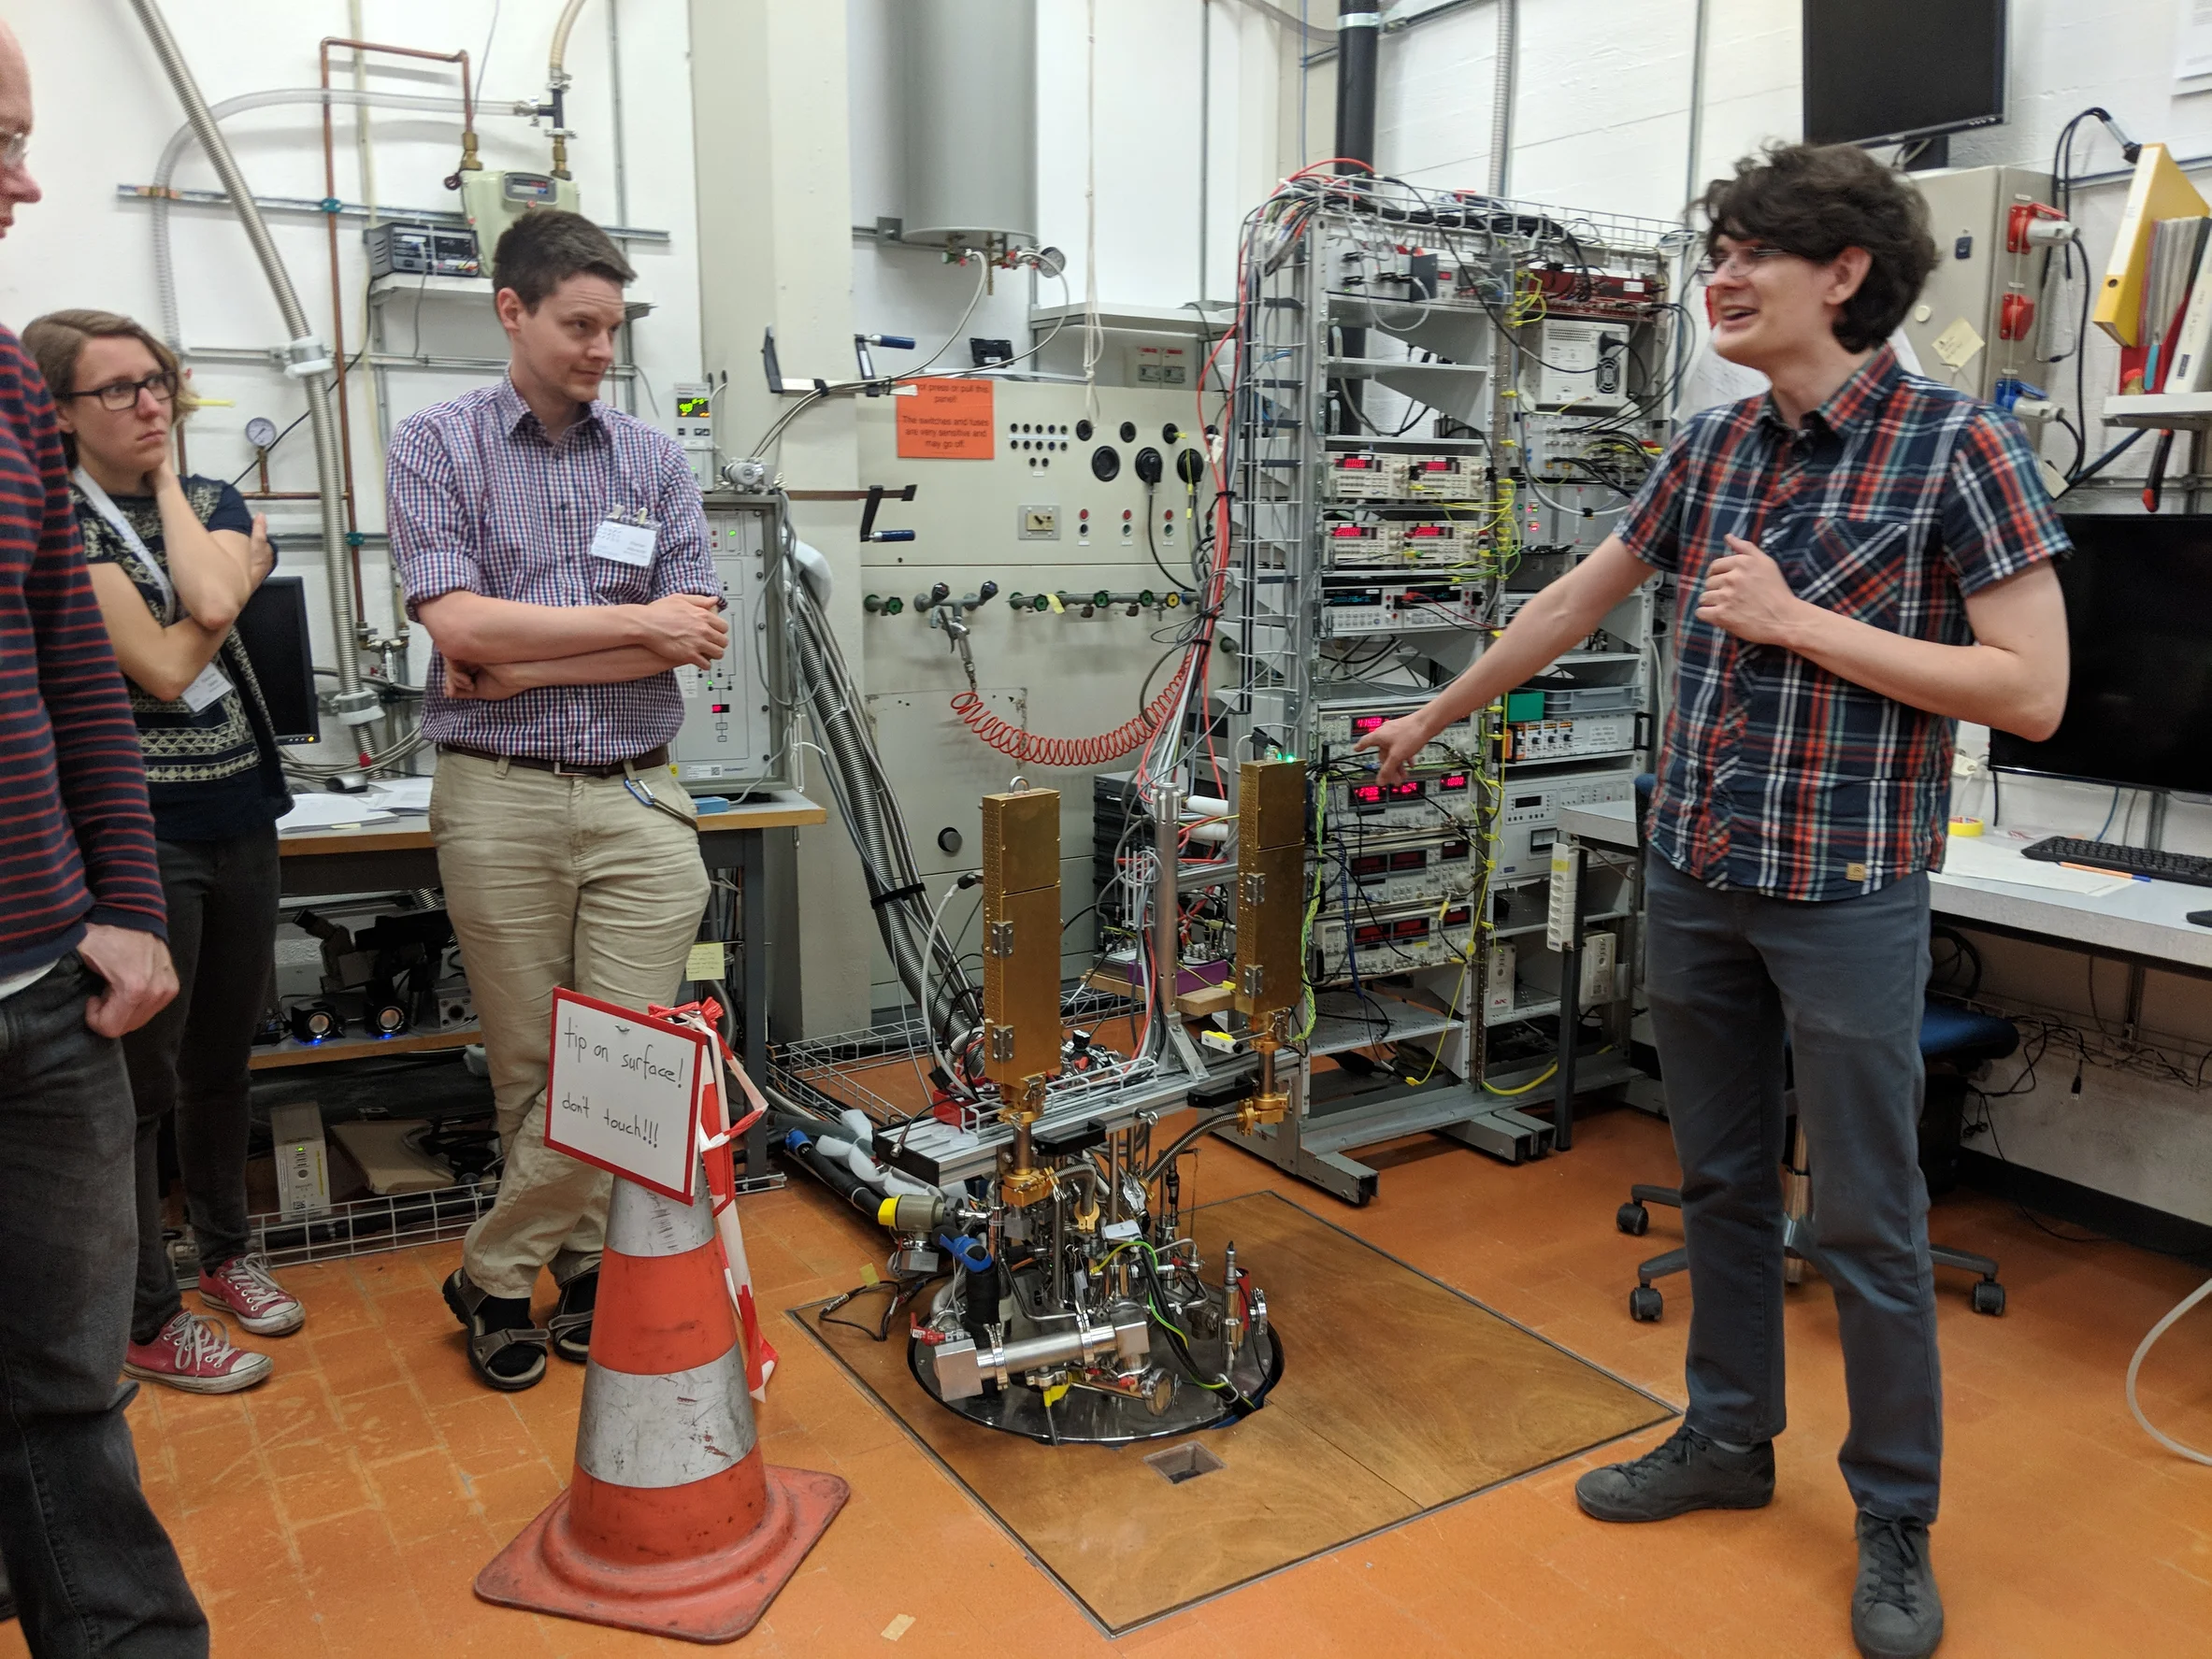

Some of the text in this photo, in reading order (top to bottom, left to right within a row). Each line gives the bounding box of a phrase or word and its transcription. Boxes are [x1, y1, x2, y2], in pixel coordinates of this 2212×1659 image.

[902, 415, 916, 423] The
[919, 417, 952, 425] switches
[920, 429, 936, 437] very
[939, 428, 970, 436] sensitive
[925, 440, 941, 449] may
[942, 441, 953, 450] go
[564, 1017, 683, 1088] tip on surface!
[562, 1092, 659, 1149] don't touch!!!
